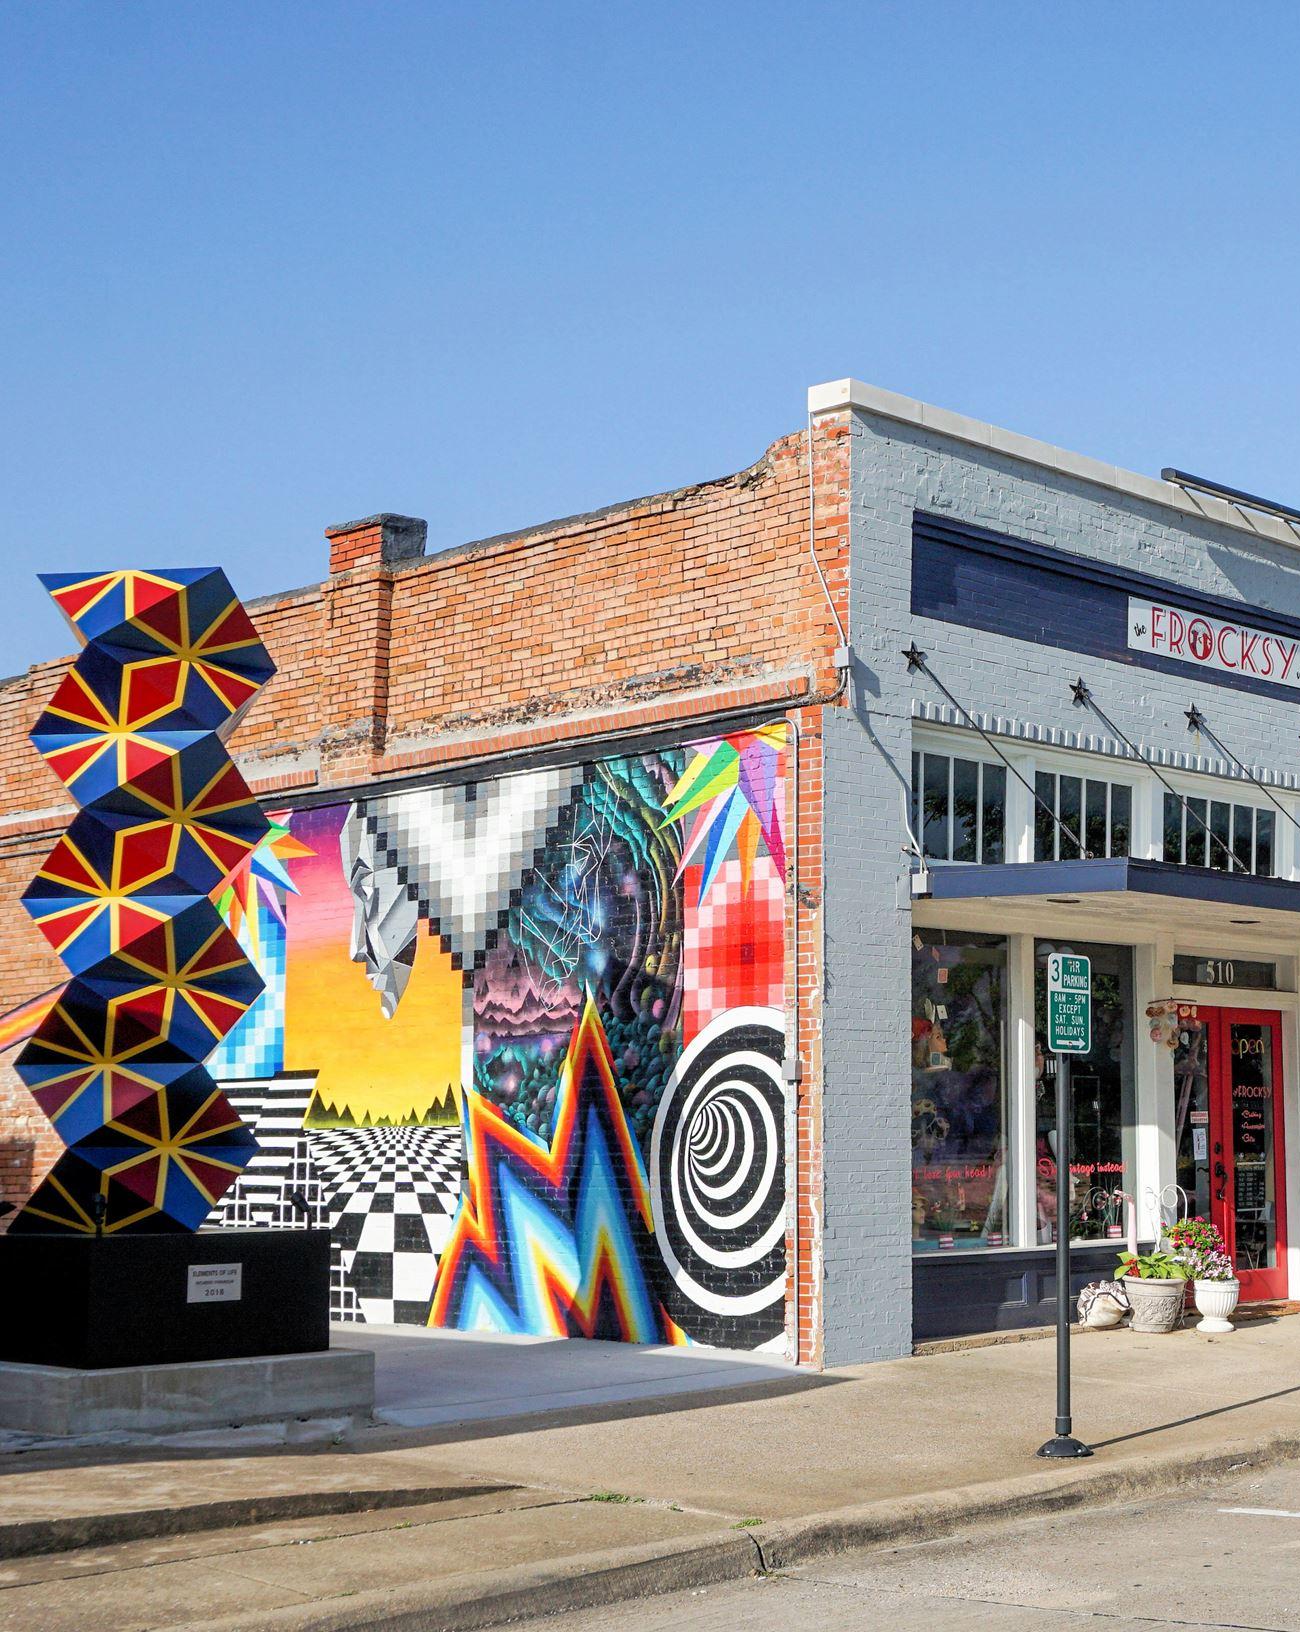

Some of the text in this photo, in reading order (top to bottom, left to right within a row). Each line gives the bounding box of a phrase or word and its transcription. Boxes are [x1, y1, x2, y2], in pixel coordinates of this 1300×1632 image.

[1134, 606, 1299, 680] the FROCKSY
[1051, 959, 1081, 982] 3 HR
[1206, 960, 1234, 985] 510
[1063, 974, 1088, 988] PARKING
[1053, 993, 1066, 1003] 8AM
[1074, 994, 1086, 1005] 5PM
[1058, 1005, 1081, 1014] EXCEPT
[1055, 1014, 1068, 1024] SAT.
[1055, 1025, 1085, 1037] HOLIDAYS
[1238, 1085, 1272, 1099] FROCKSY
[1069, 1163, 1095, 1177] intage
